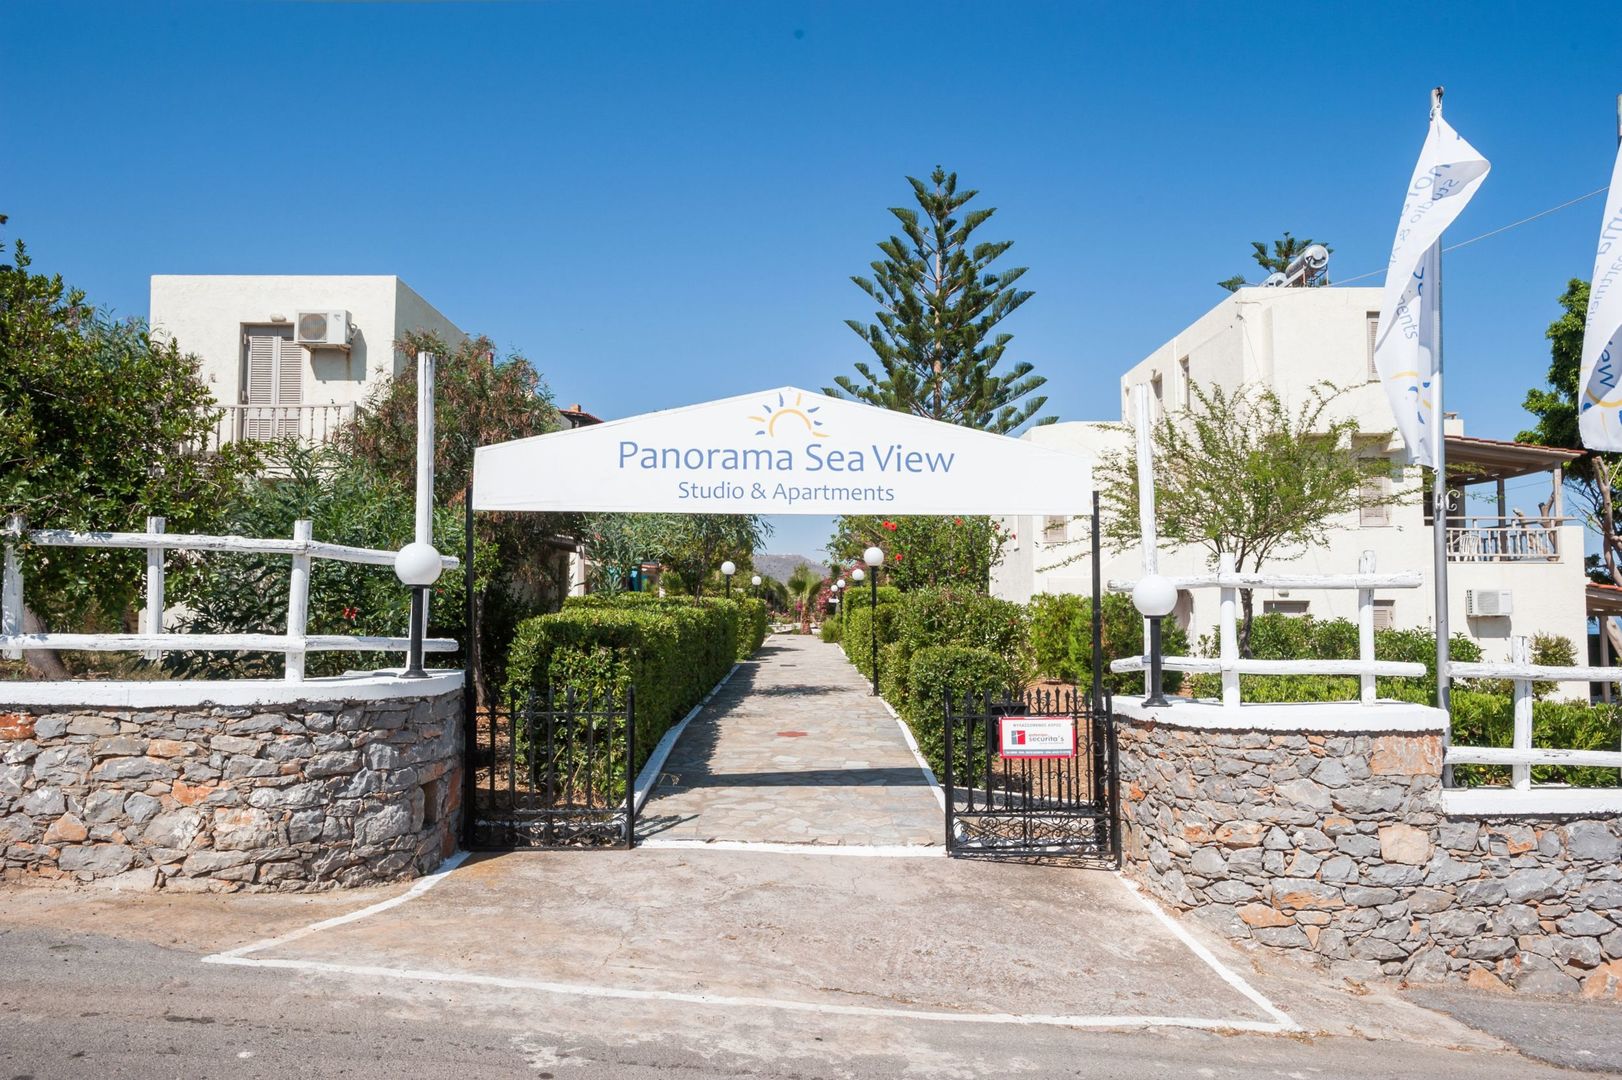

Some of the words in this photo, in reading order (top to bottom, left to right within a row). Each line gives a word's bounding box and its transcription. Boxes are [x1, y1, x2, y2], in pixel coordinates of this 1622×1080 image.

[619, 441, 793, 471] Panorama
[805, 443, 865, 472] Sea
[871, 444, 955, 473] View
[678, 481, 745, 499] Studio
[750, 483, 767, 499] &
[772, 483, 895, 505] Apartments
